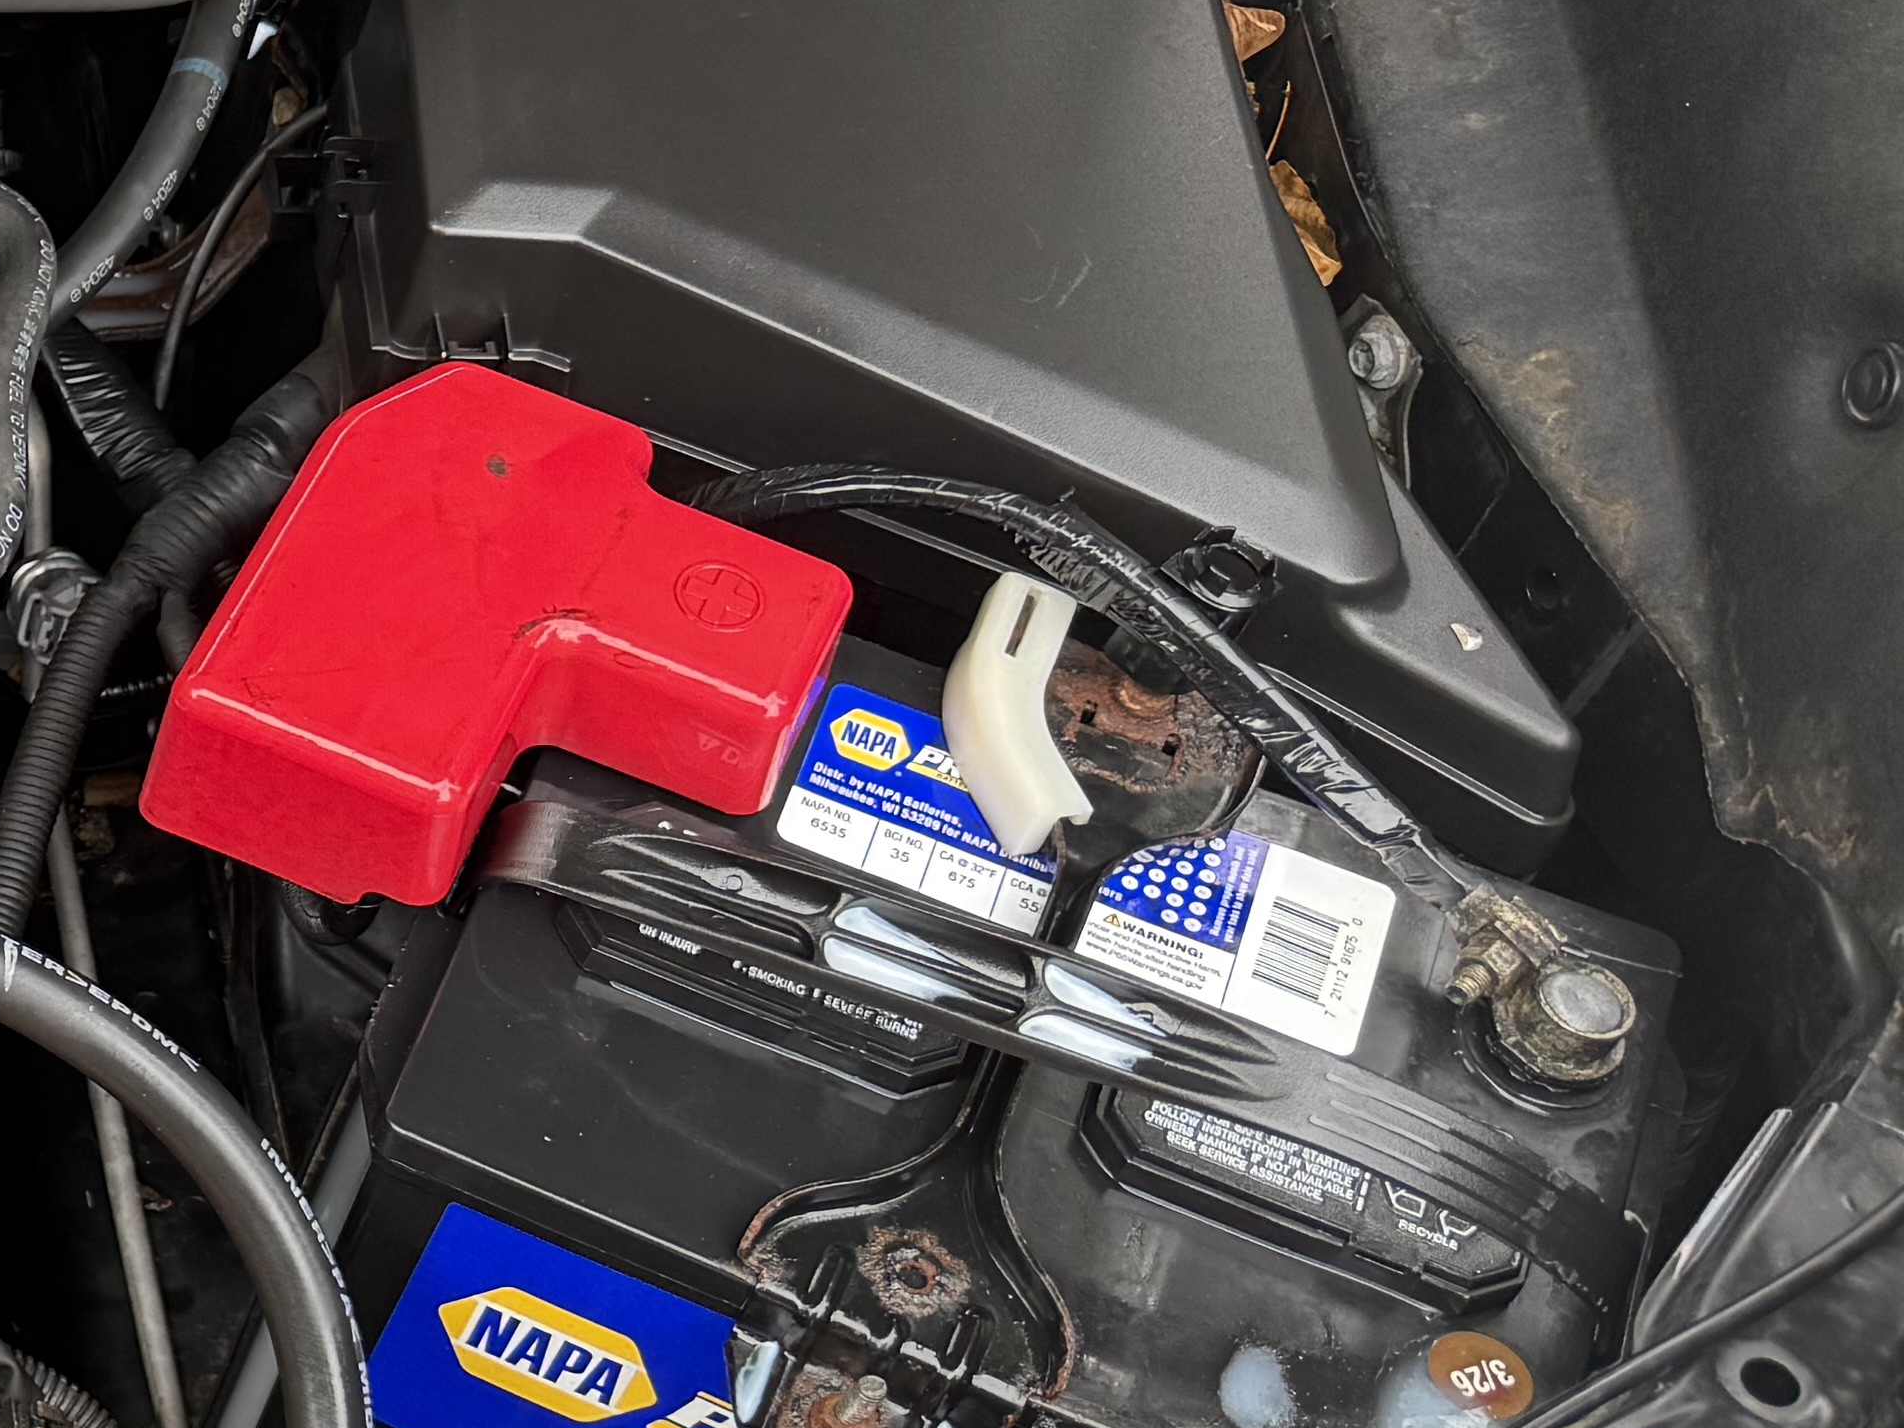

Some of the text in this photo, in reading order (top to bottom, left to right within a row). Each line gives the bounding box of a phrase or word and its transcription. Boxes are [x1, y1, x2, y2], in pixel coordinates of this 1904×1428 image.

[3, 502, 25, 532] DO
[841, 721, 897, 760] NAPA
[850, 776, 865, 792] by
[866, 779, 900, 803] NAPA
[801, 796, 832, 816] NAPA
[810, 817, 847, 839] 6535
[882, 801, 899, 814] WI
[941, 823, 960, 839] for
[961, 832, 997, 854] NAPA
[884, 829, 903, 843] BCI
[890, 848, 910, 863] 35
[940, 850, 954, 864] CA
[948, 870, 976, 889] 675
[1010, 877, 1034, 894] CCA
[659, 931, 701, 955] INJURY
[1122, 920, 1204, 959] WARNING:
[747, 966, 806, 996] SMOKING
[1324, 1009, 1337, 1019] 7
[1351, 917, 1363, 926] 0
[1144, 1110, 1355, 1201] OWNERS IF NOT AVAILABLE
[1150, 1100, 1199, 1127] FOLLOW
[1201, 1120, 1285, 1163] INSTRUCTIONS
[1291, 1152, 1303, 1168] IN
[1304, 1157, 1354, 1188] VEHICLE
[1166, 1130, 1197, 1155] SEEK
[1198, 1142, 1247, 1173] SERVICE
[1267, 1131, 1300, 1155] JUMP
[1302, 1145, 1361, 1177] STARTING
[1398, 1218, 1459, 1251] RECYCLE
[464, 1304, 624, 1407] NAPA
[1450, 1359, 1516, 1397] 3/26
